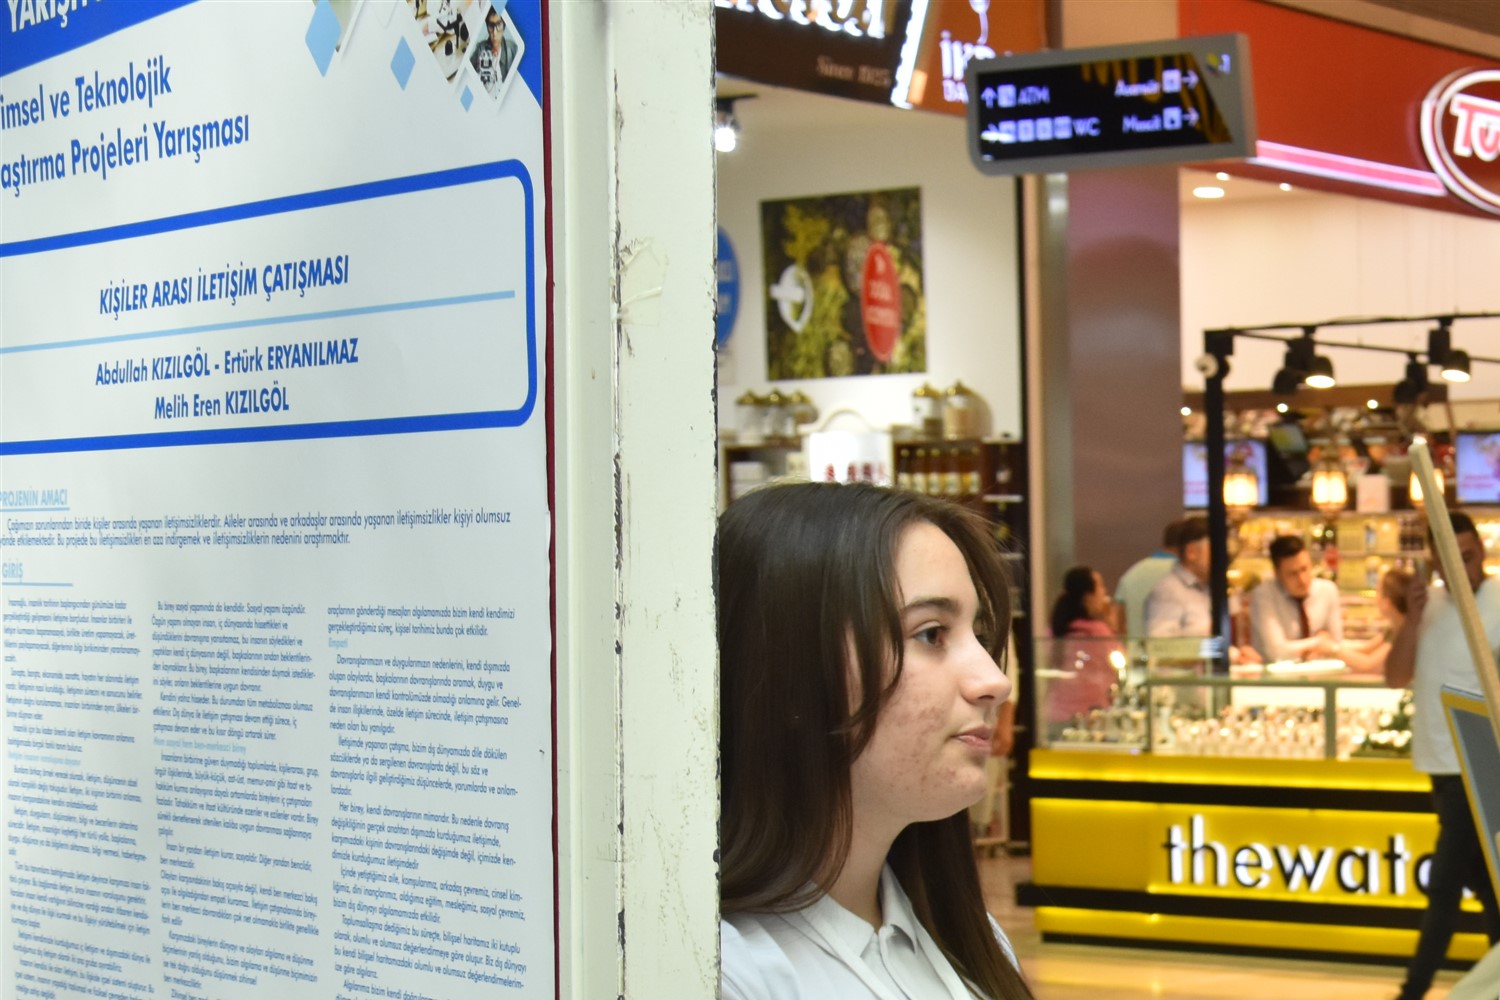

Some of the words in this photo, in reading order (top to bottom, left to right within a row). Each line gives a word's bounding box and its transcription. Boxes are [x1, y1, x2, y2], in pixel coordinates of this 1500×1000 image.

[7, 0, 104, 32] YARIŞ
[50, 91, 70, 118] ve
[76, 55, 172, 112] Teknolojik
[1073, 118, 1100, 136] WC
[72, 124, 148, 180] Projeleri
[153, 115, 249, 164] Yarışması
[100, 281, 147, 320] KİŞİLER
[152, 277, 192, 307] ARASI
[197, 262, 257, 306] İLETİŞİM
[263, 255, 349, 301] ÇATIŞMASI
[96, 359, 148, 385] Abdullah
[152, 347, 210, 380] KIZILGÖL
[224, 347, 263, 374] Ertürk
[268, 338, 358, 370] ERYANILMAZ
[154, 394, 188, 419] Melih
[194, 394, 220, 416] Eren
[226, 381, 289, 414] KIZILGÖL
[41, 489, 68, 505] AMACI
[223, 514, 246, 528] Aileler
[279, 517, 288, 526] ve
[289, 512, 327, 531] arkadaşlar
[453, 509, 473, 527] kişiyi
[475, 508, 510, 523] olumsuz
[468, 607, 484, 618] kendi
[485, 607, 515, 618] kendimizi
